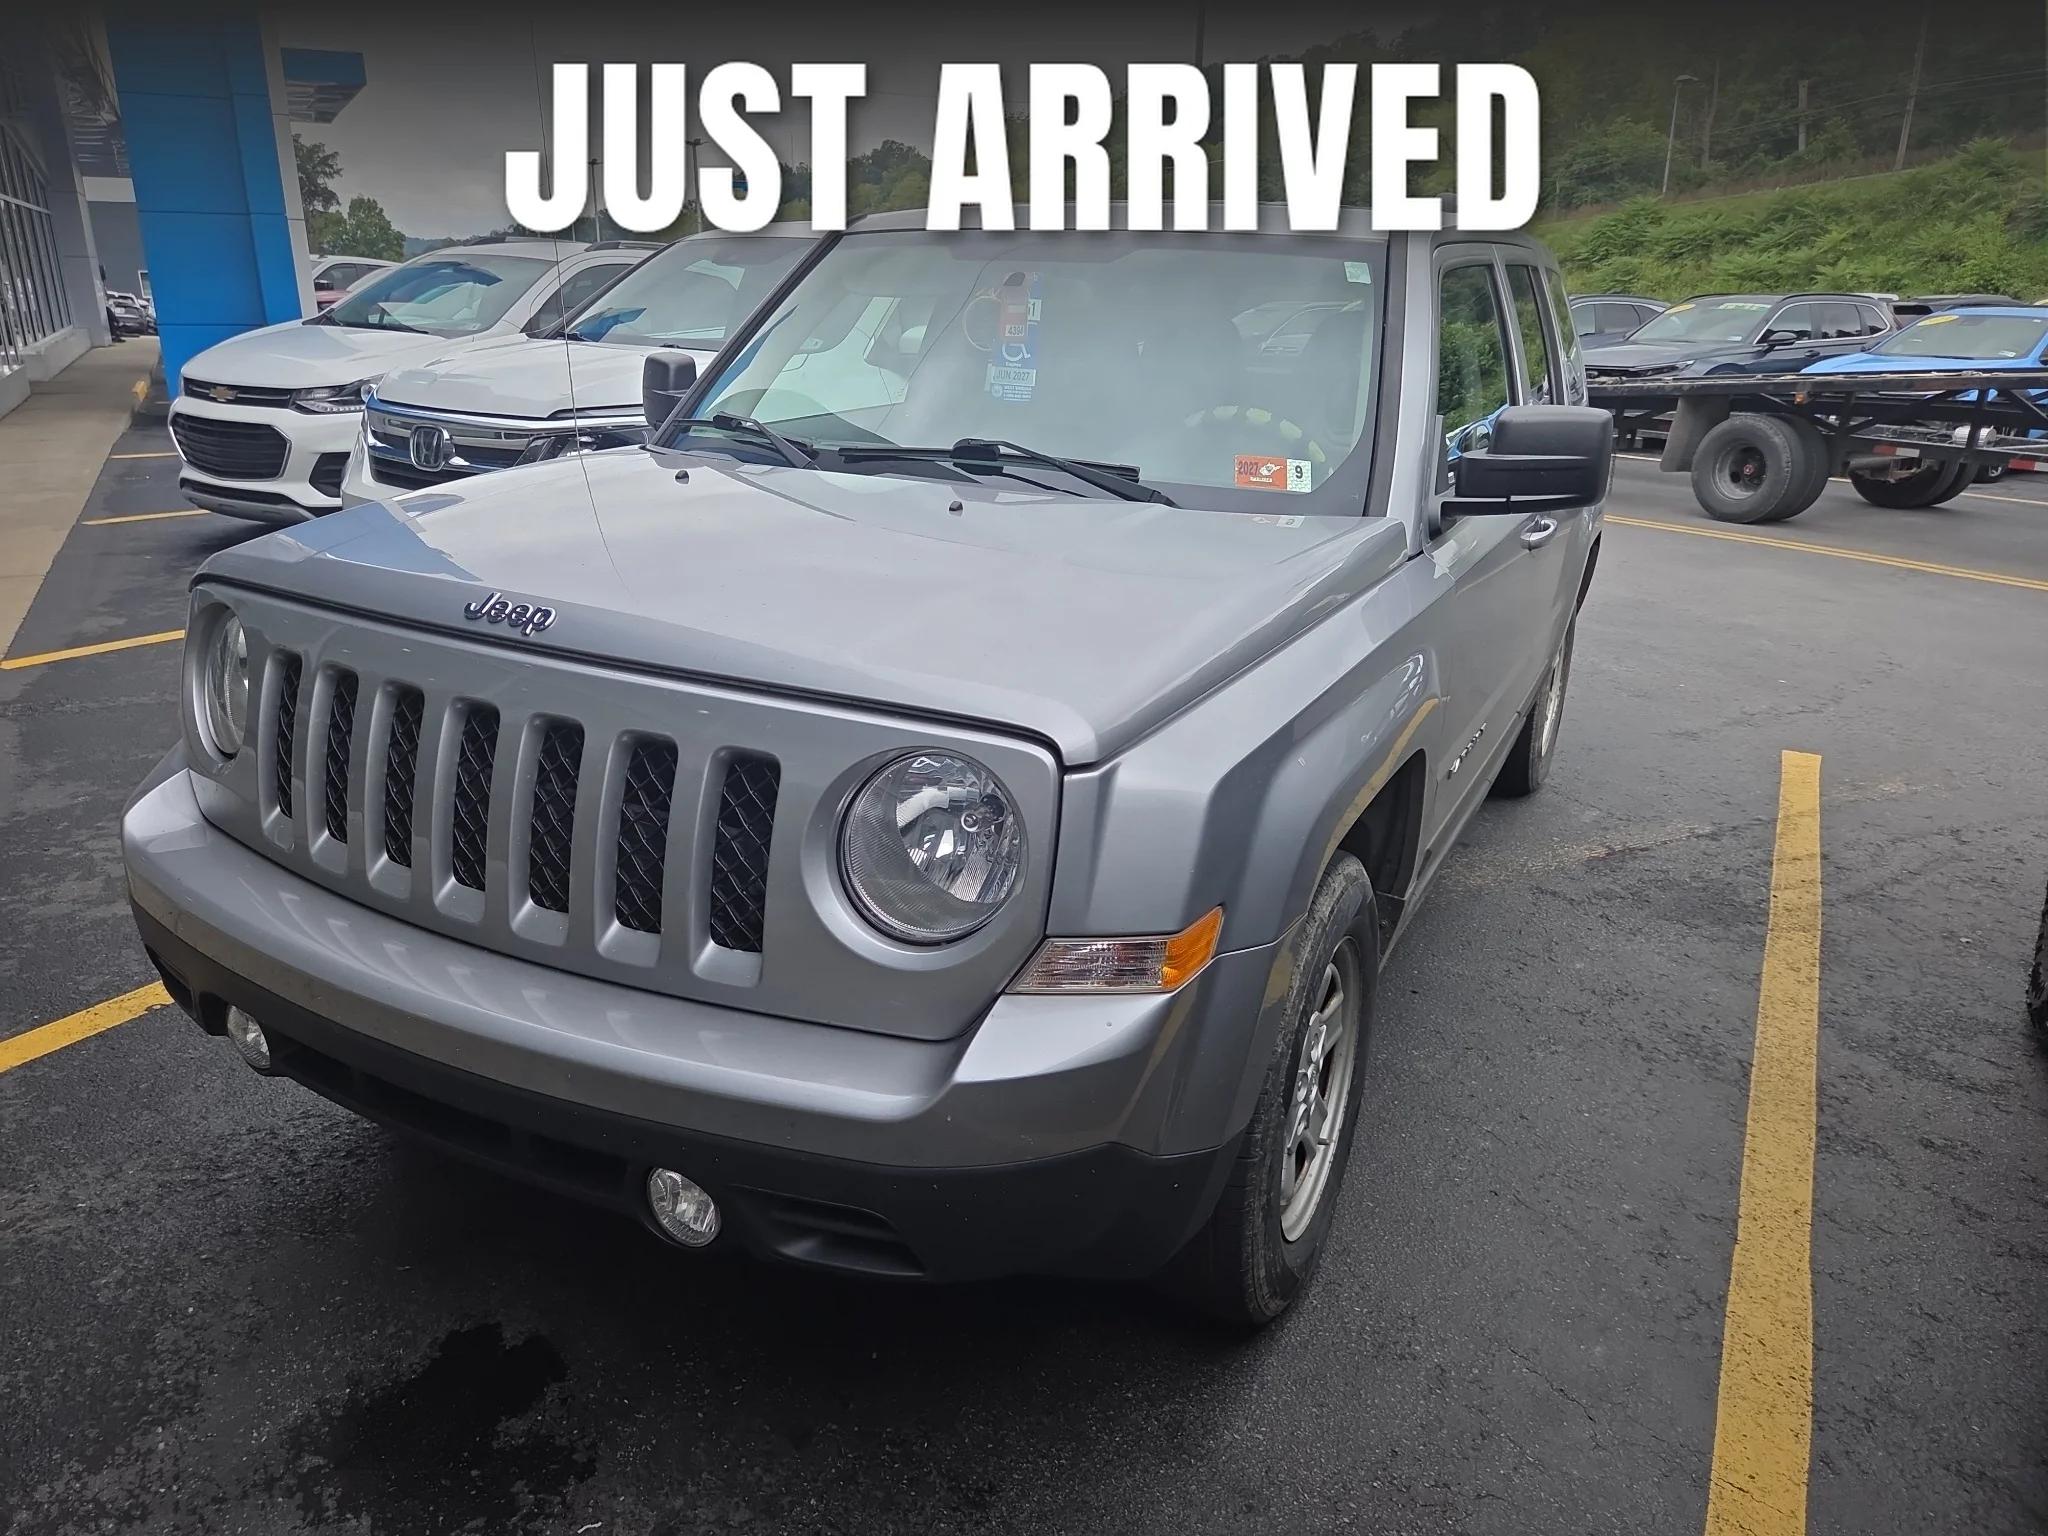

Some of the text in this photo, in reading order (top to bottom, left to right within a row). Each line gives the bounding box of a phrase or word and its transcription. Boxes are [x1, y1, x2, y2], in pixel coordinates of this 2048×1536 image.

[1238, 461, 1259, 476] 2027
[1295, 465, 1304, 479] 9
[463, 591, 558, 637] Jeep
